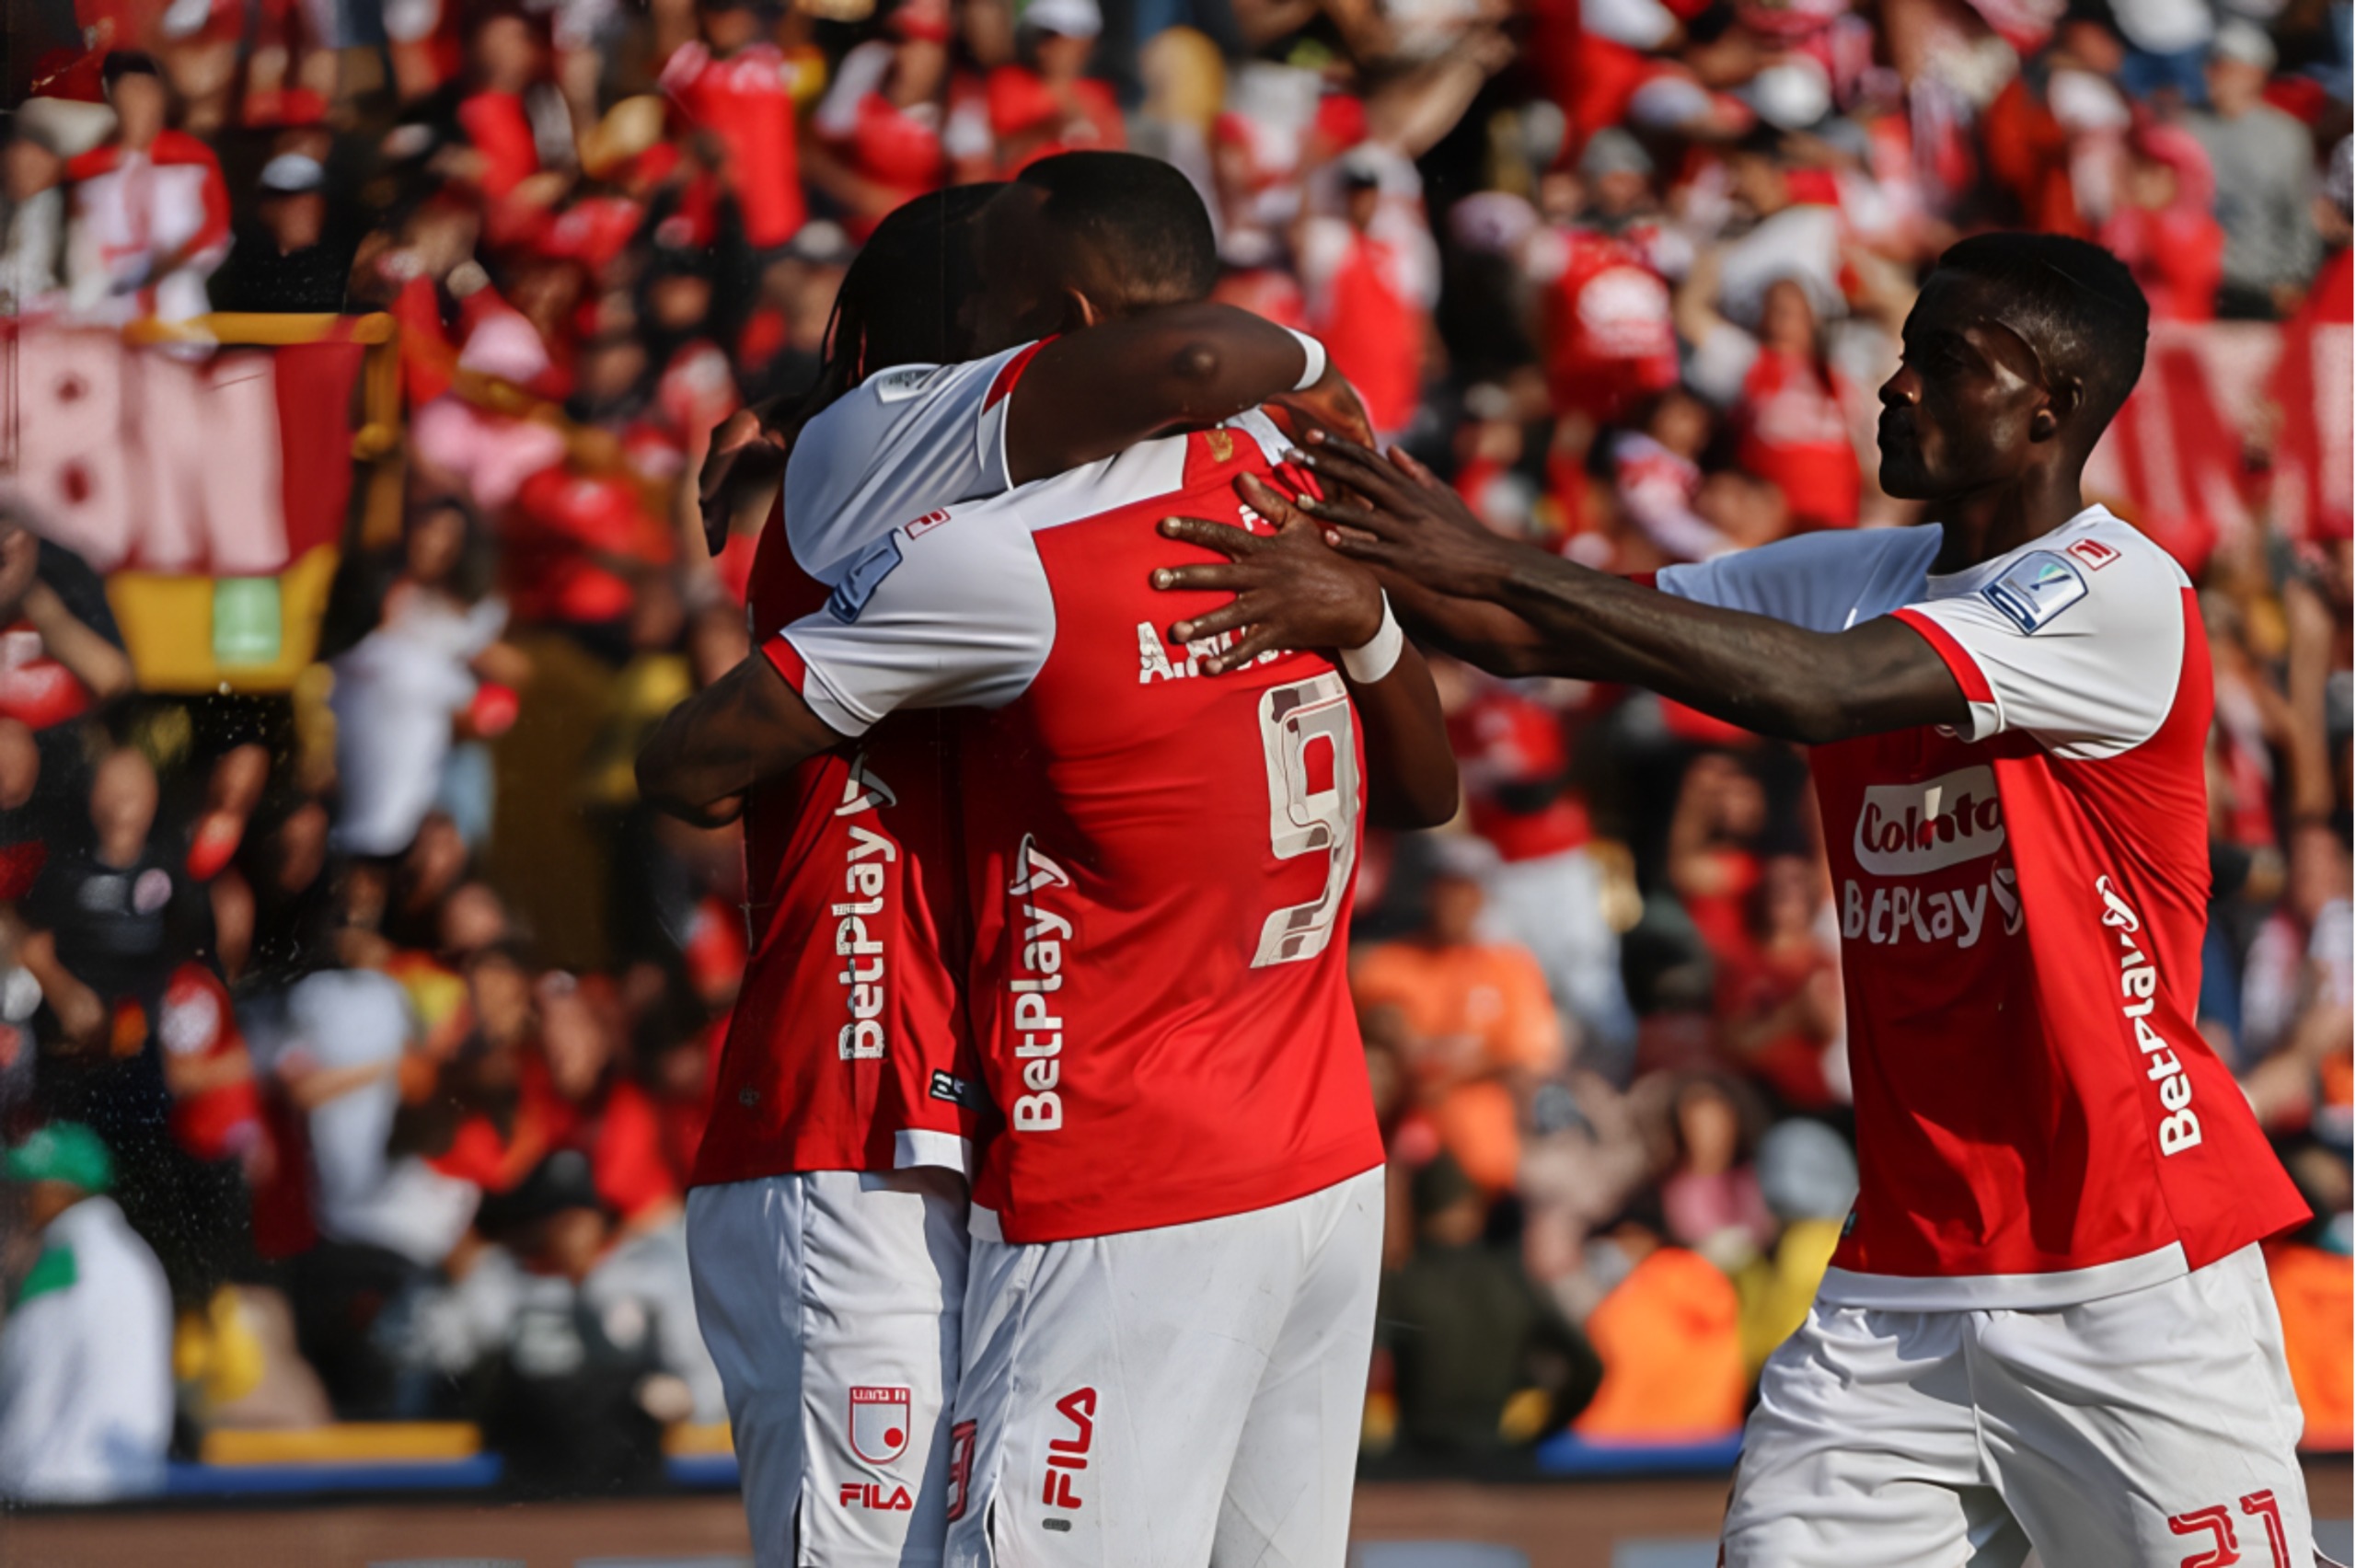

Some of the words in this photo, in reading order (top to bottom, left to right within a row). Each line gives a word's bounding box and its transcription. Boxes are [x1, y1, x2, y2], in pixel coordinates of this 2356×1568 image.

[1250, 671, 1358, 968] 9
[832, 825, 896, 1059] BetPlay
[1842, 879, 1988, 948] BtPlay
[1010, 905, 1072, 1131] BetPlay
[839, 1482, 914, 1511] FILA
[1042, 1387, 1097, 1509] FILA
